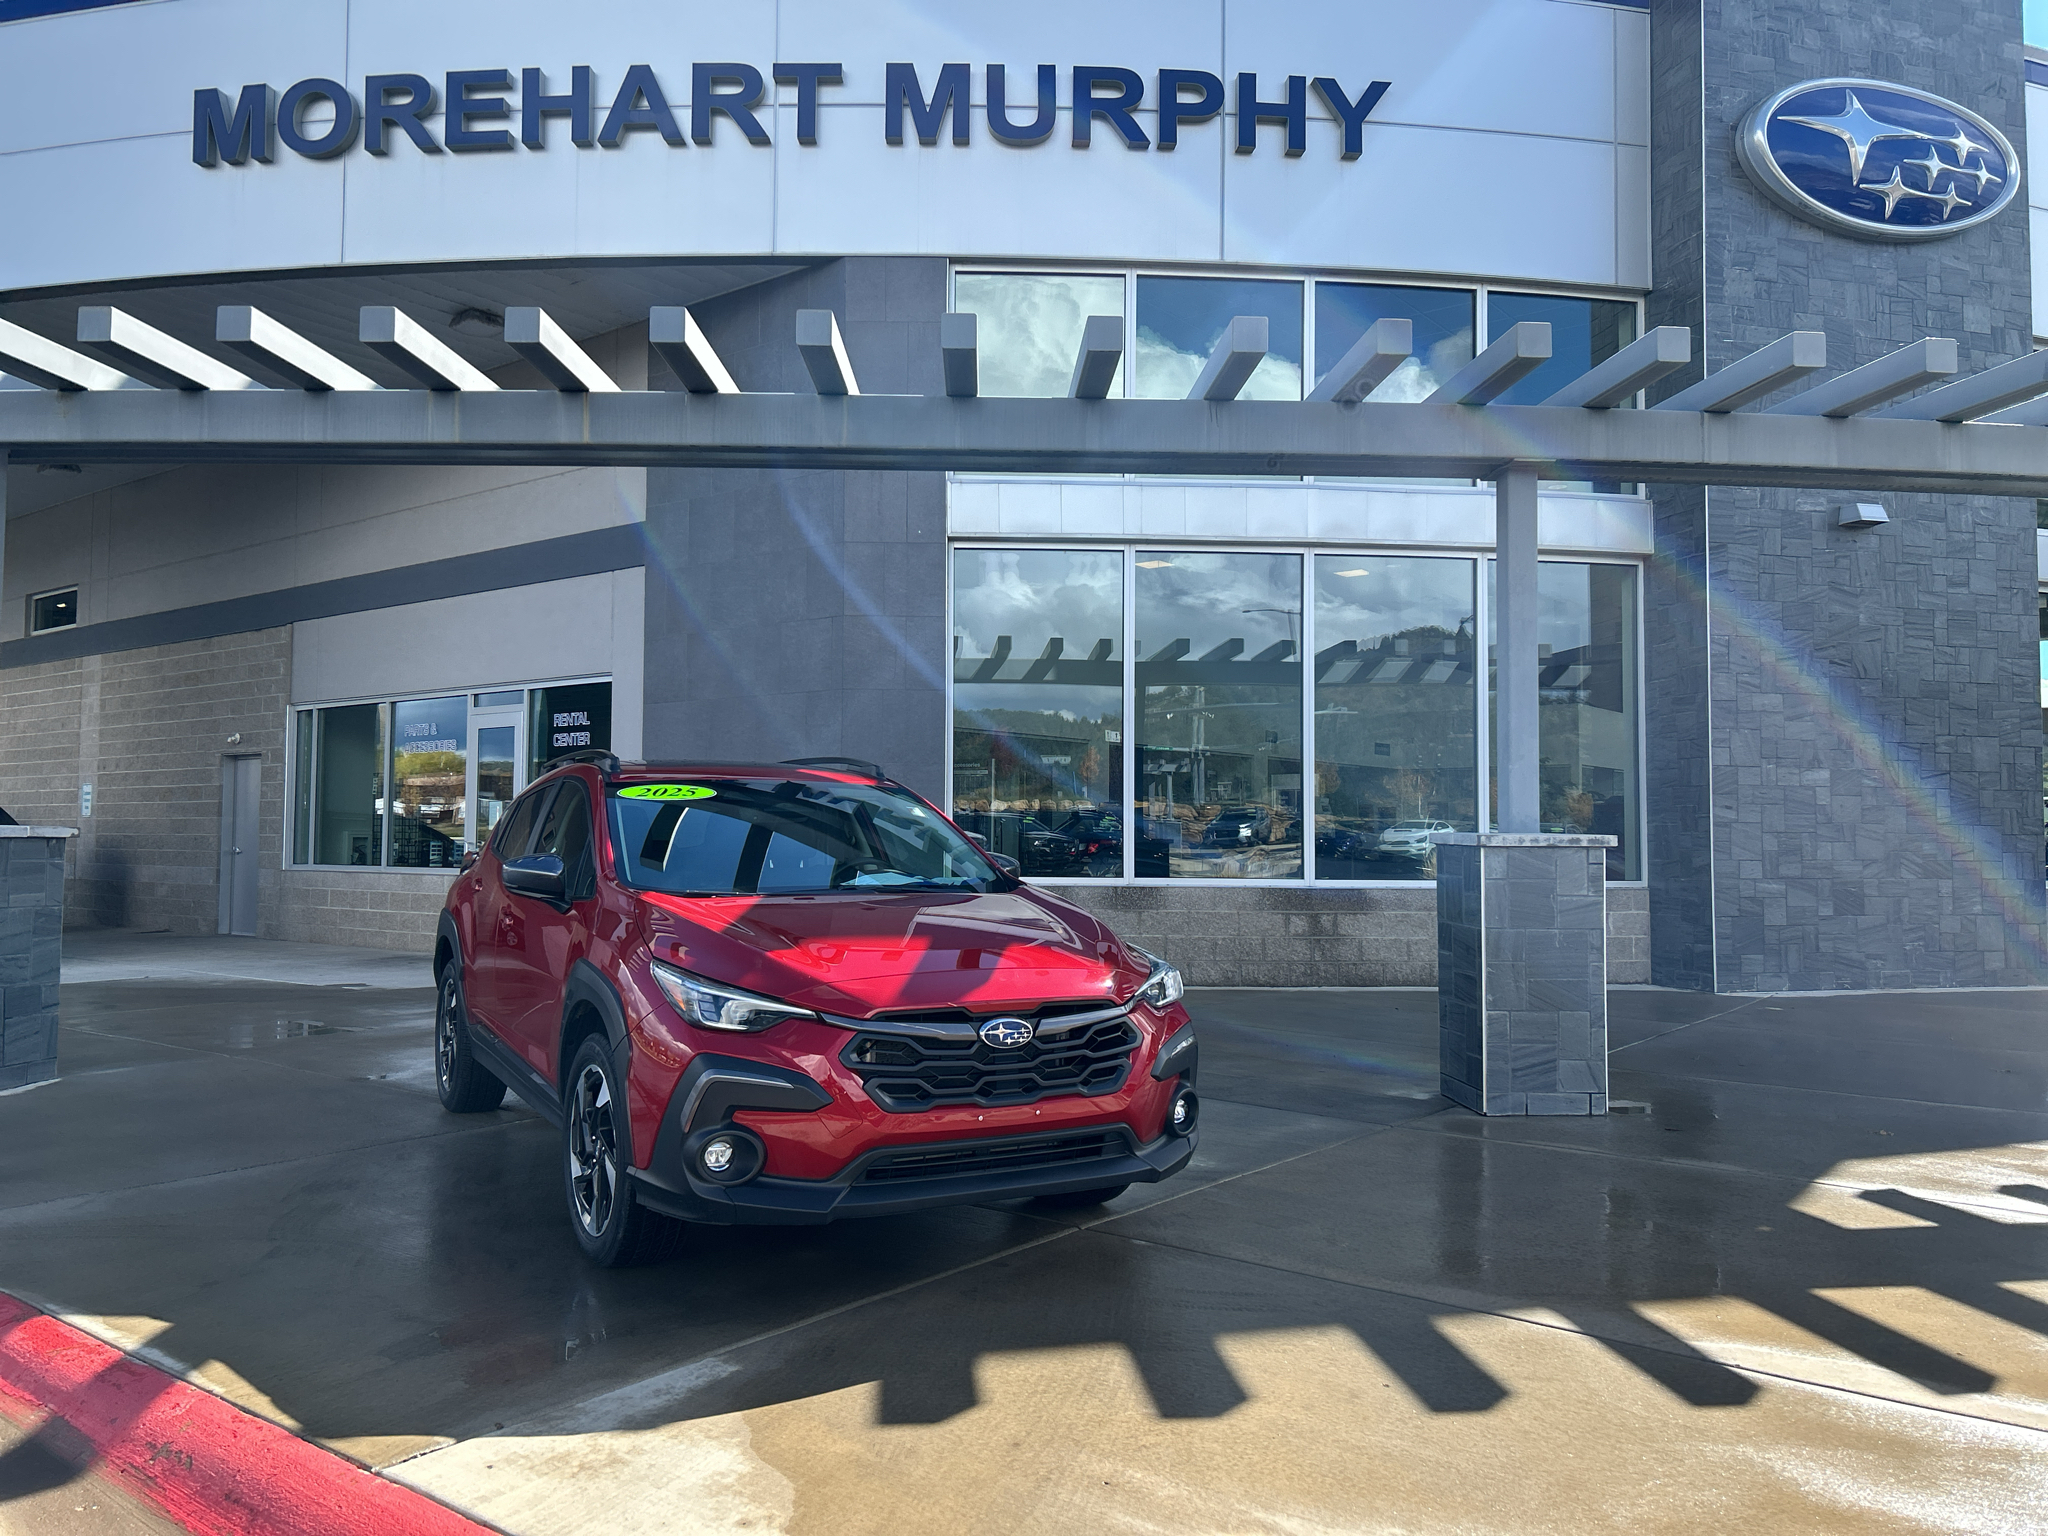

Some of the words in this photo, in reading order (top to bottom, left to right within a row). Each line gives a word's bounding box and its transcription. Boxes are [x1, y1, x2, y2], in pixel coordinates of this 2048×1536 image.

[192, 62, 844, 168] MOREHART
[884, 62, 1393, 161] MURPHY
[553, 711, 591, 727] RENTAL
[404, 723, 430, 737] PARTS
[430, 722, 438, 736] &
[553, 731, 591, 747] CENTER
[635, 787, 699, 798] 2025
